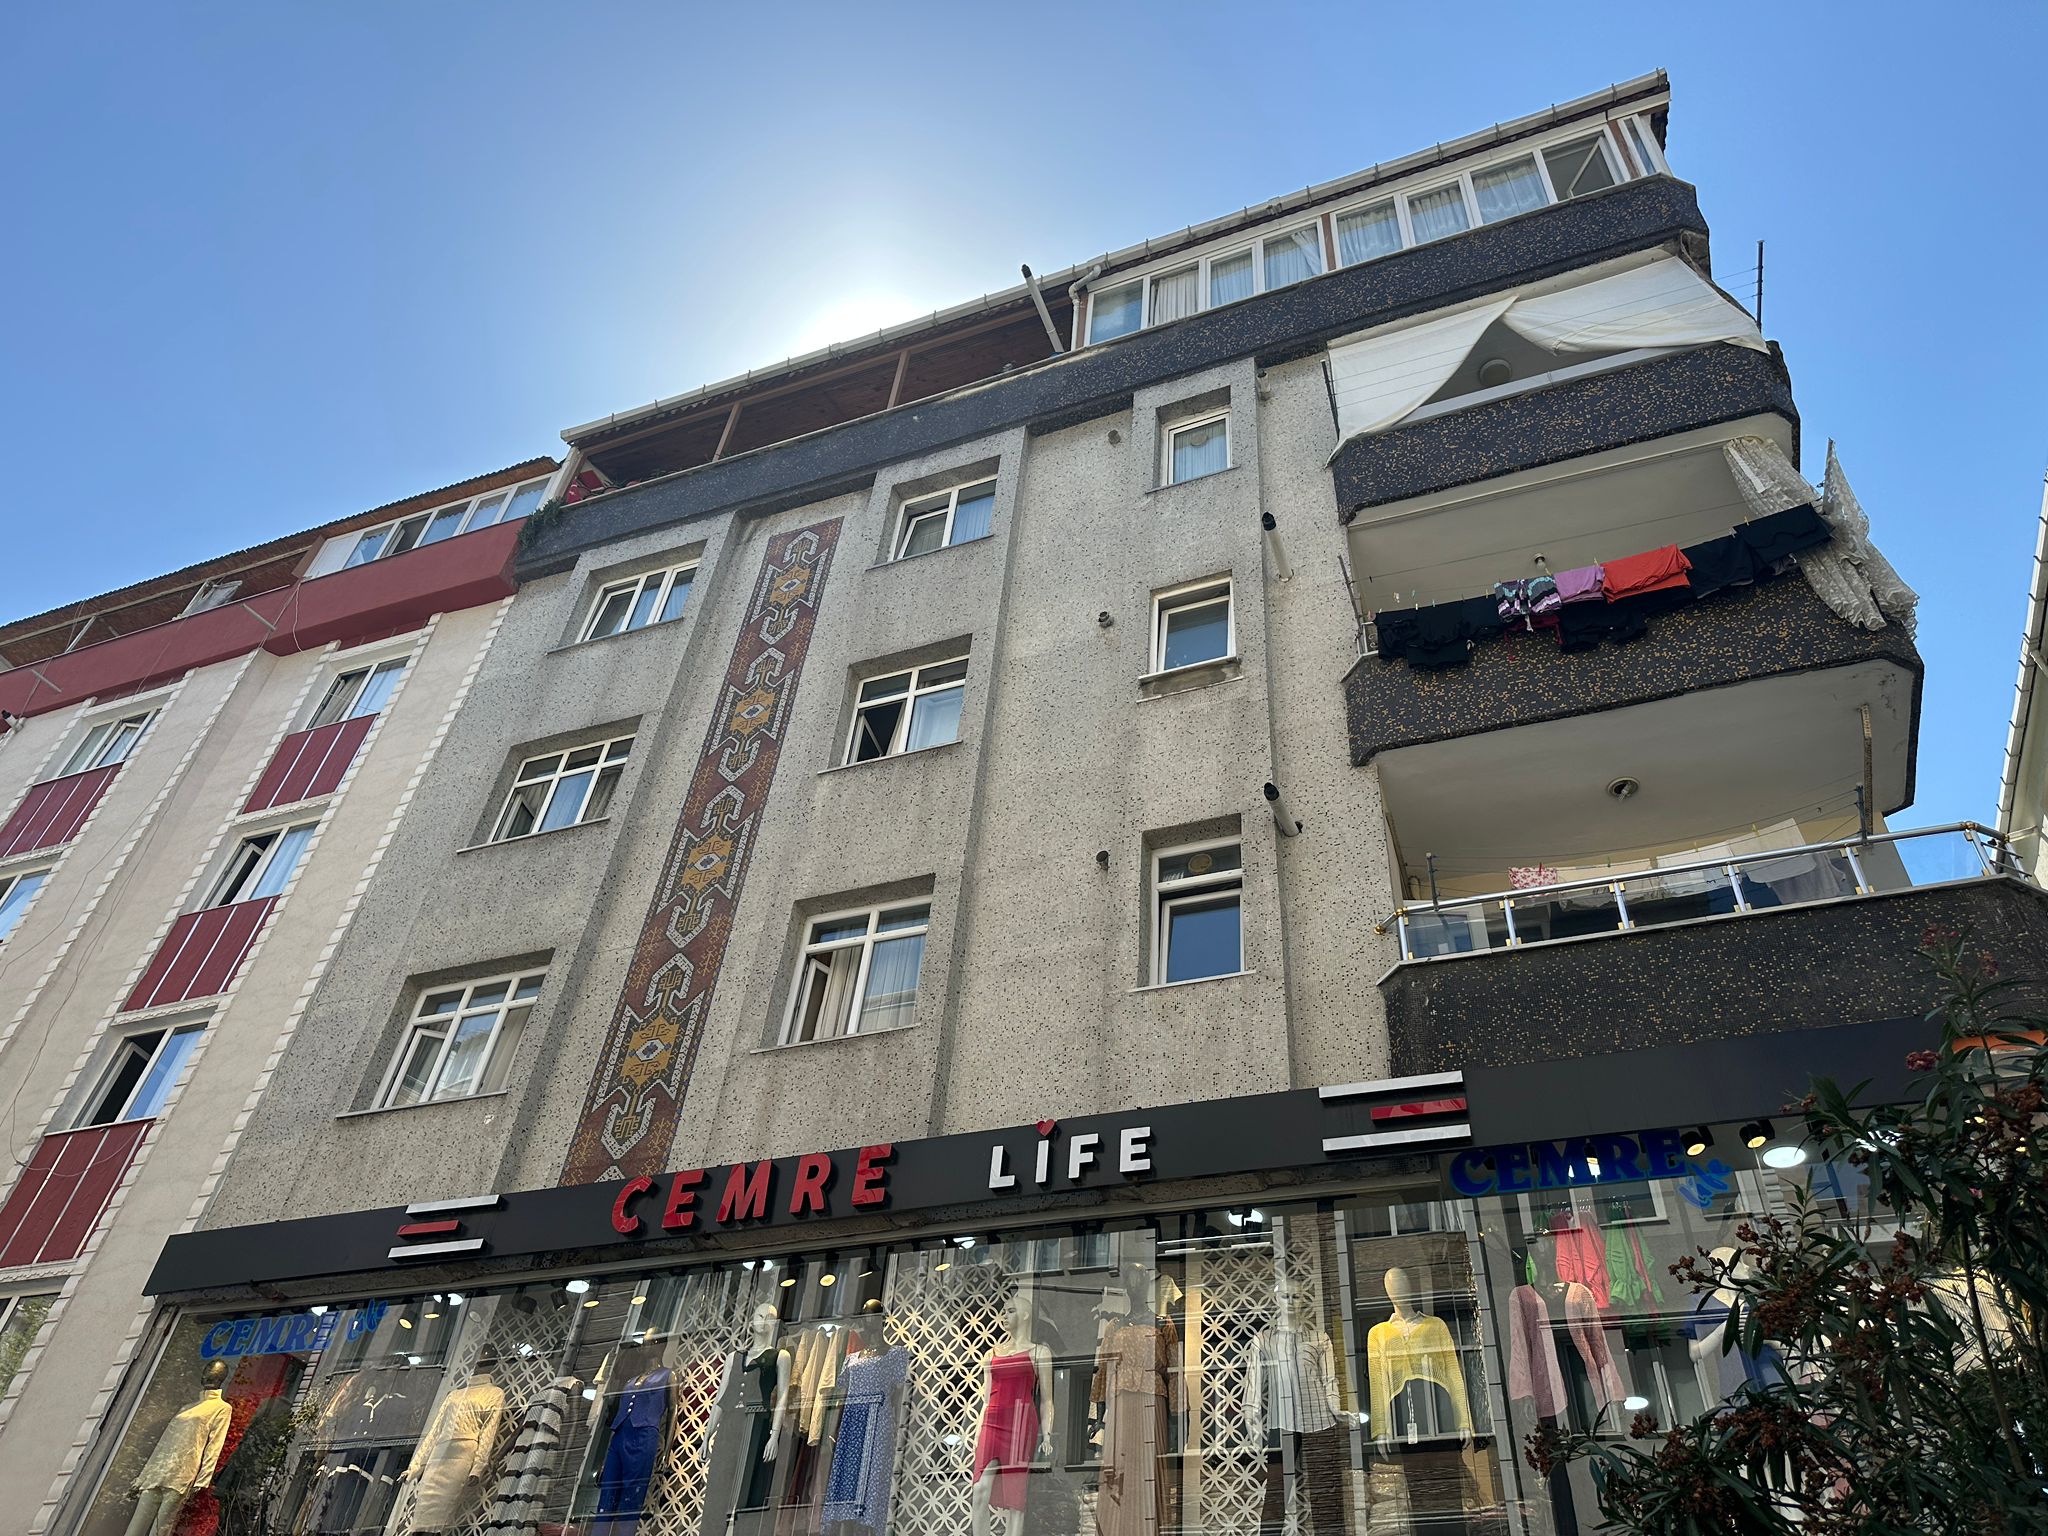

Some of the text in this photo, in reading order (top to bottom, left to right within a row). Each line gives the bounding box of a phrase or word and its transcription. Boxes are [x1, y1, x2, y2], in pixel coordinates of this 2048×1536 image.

[611, 1143, 893, 1234] CEMRE
[1450, 1128, 1689, 1197] CEMRE
[200, 1310, 342, 1360] CEMRE
